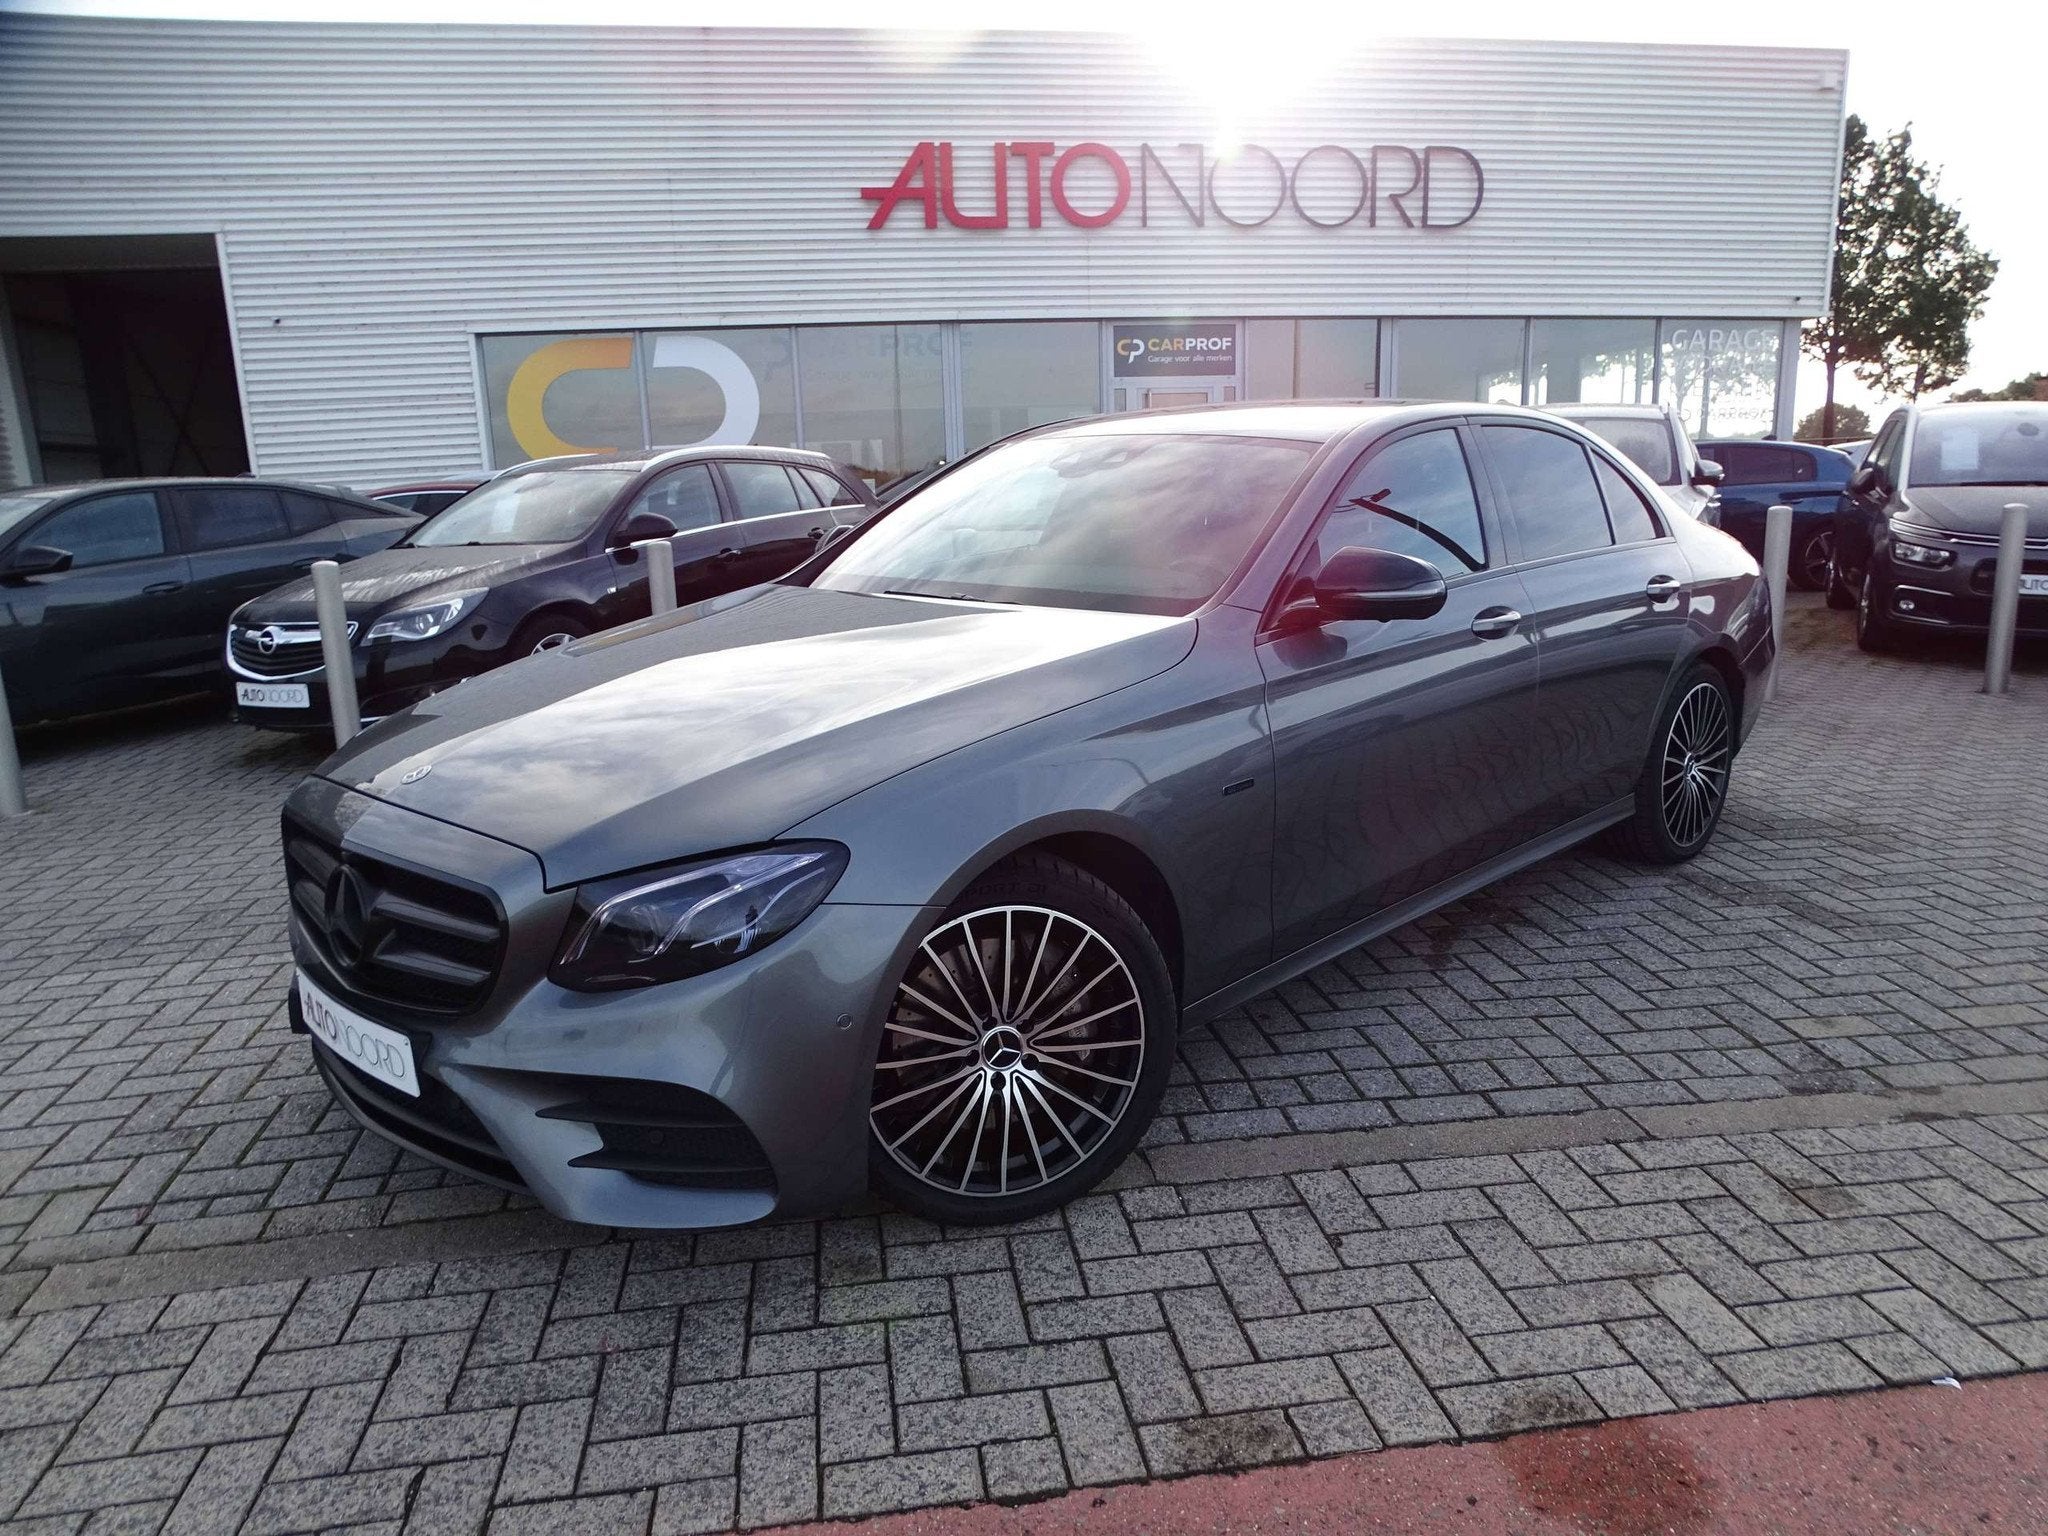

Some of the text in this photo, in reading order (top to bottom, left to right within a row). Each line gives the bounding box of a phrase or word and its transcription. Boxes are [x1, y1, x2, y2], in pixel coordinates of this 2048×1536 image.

[1147, 337, 1233, 351] CARPROF
[1147, 355, 1173, 364] Garage
[2020, 578, 2048, 591] UTO
